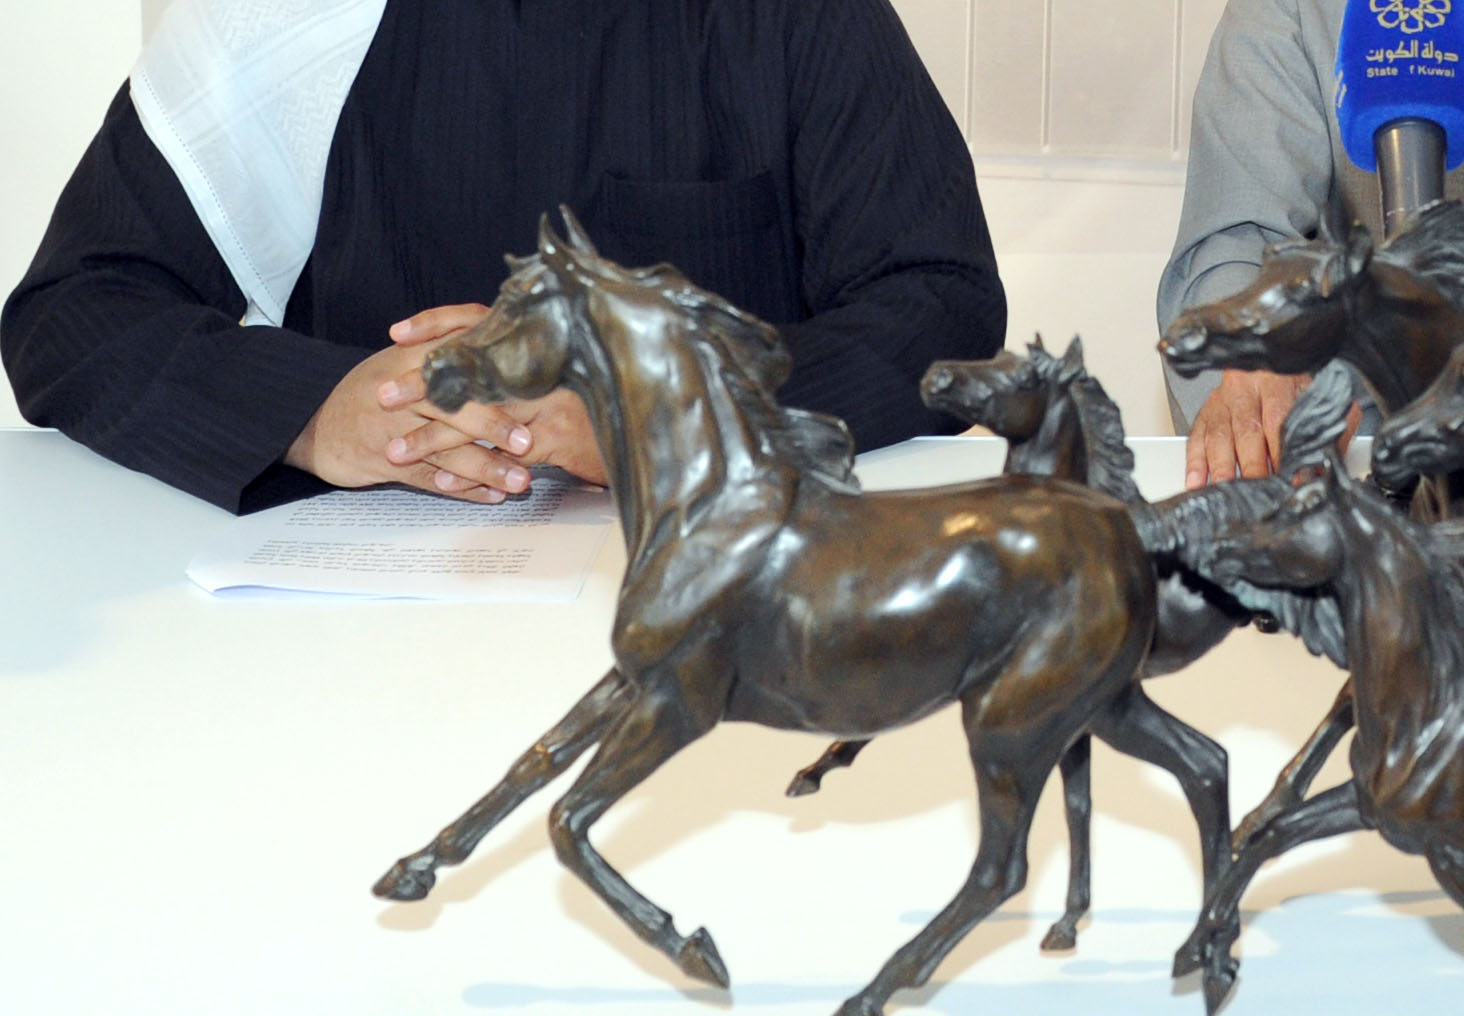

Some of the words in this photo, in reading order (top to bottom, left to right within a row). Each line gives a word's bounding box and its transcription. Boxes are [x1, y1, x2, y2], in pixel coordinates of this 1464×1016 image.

[1365, 39, 1419, 64] الكويت
[1421, 40, 1459, 64] دولة
[1366, 67, 1399, 78] State
